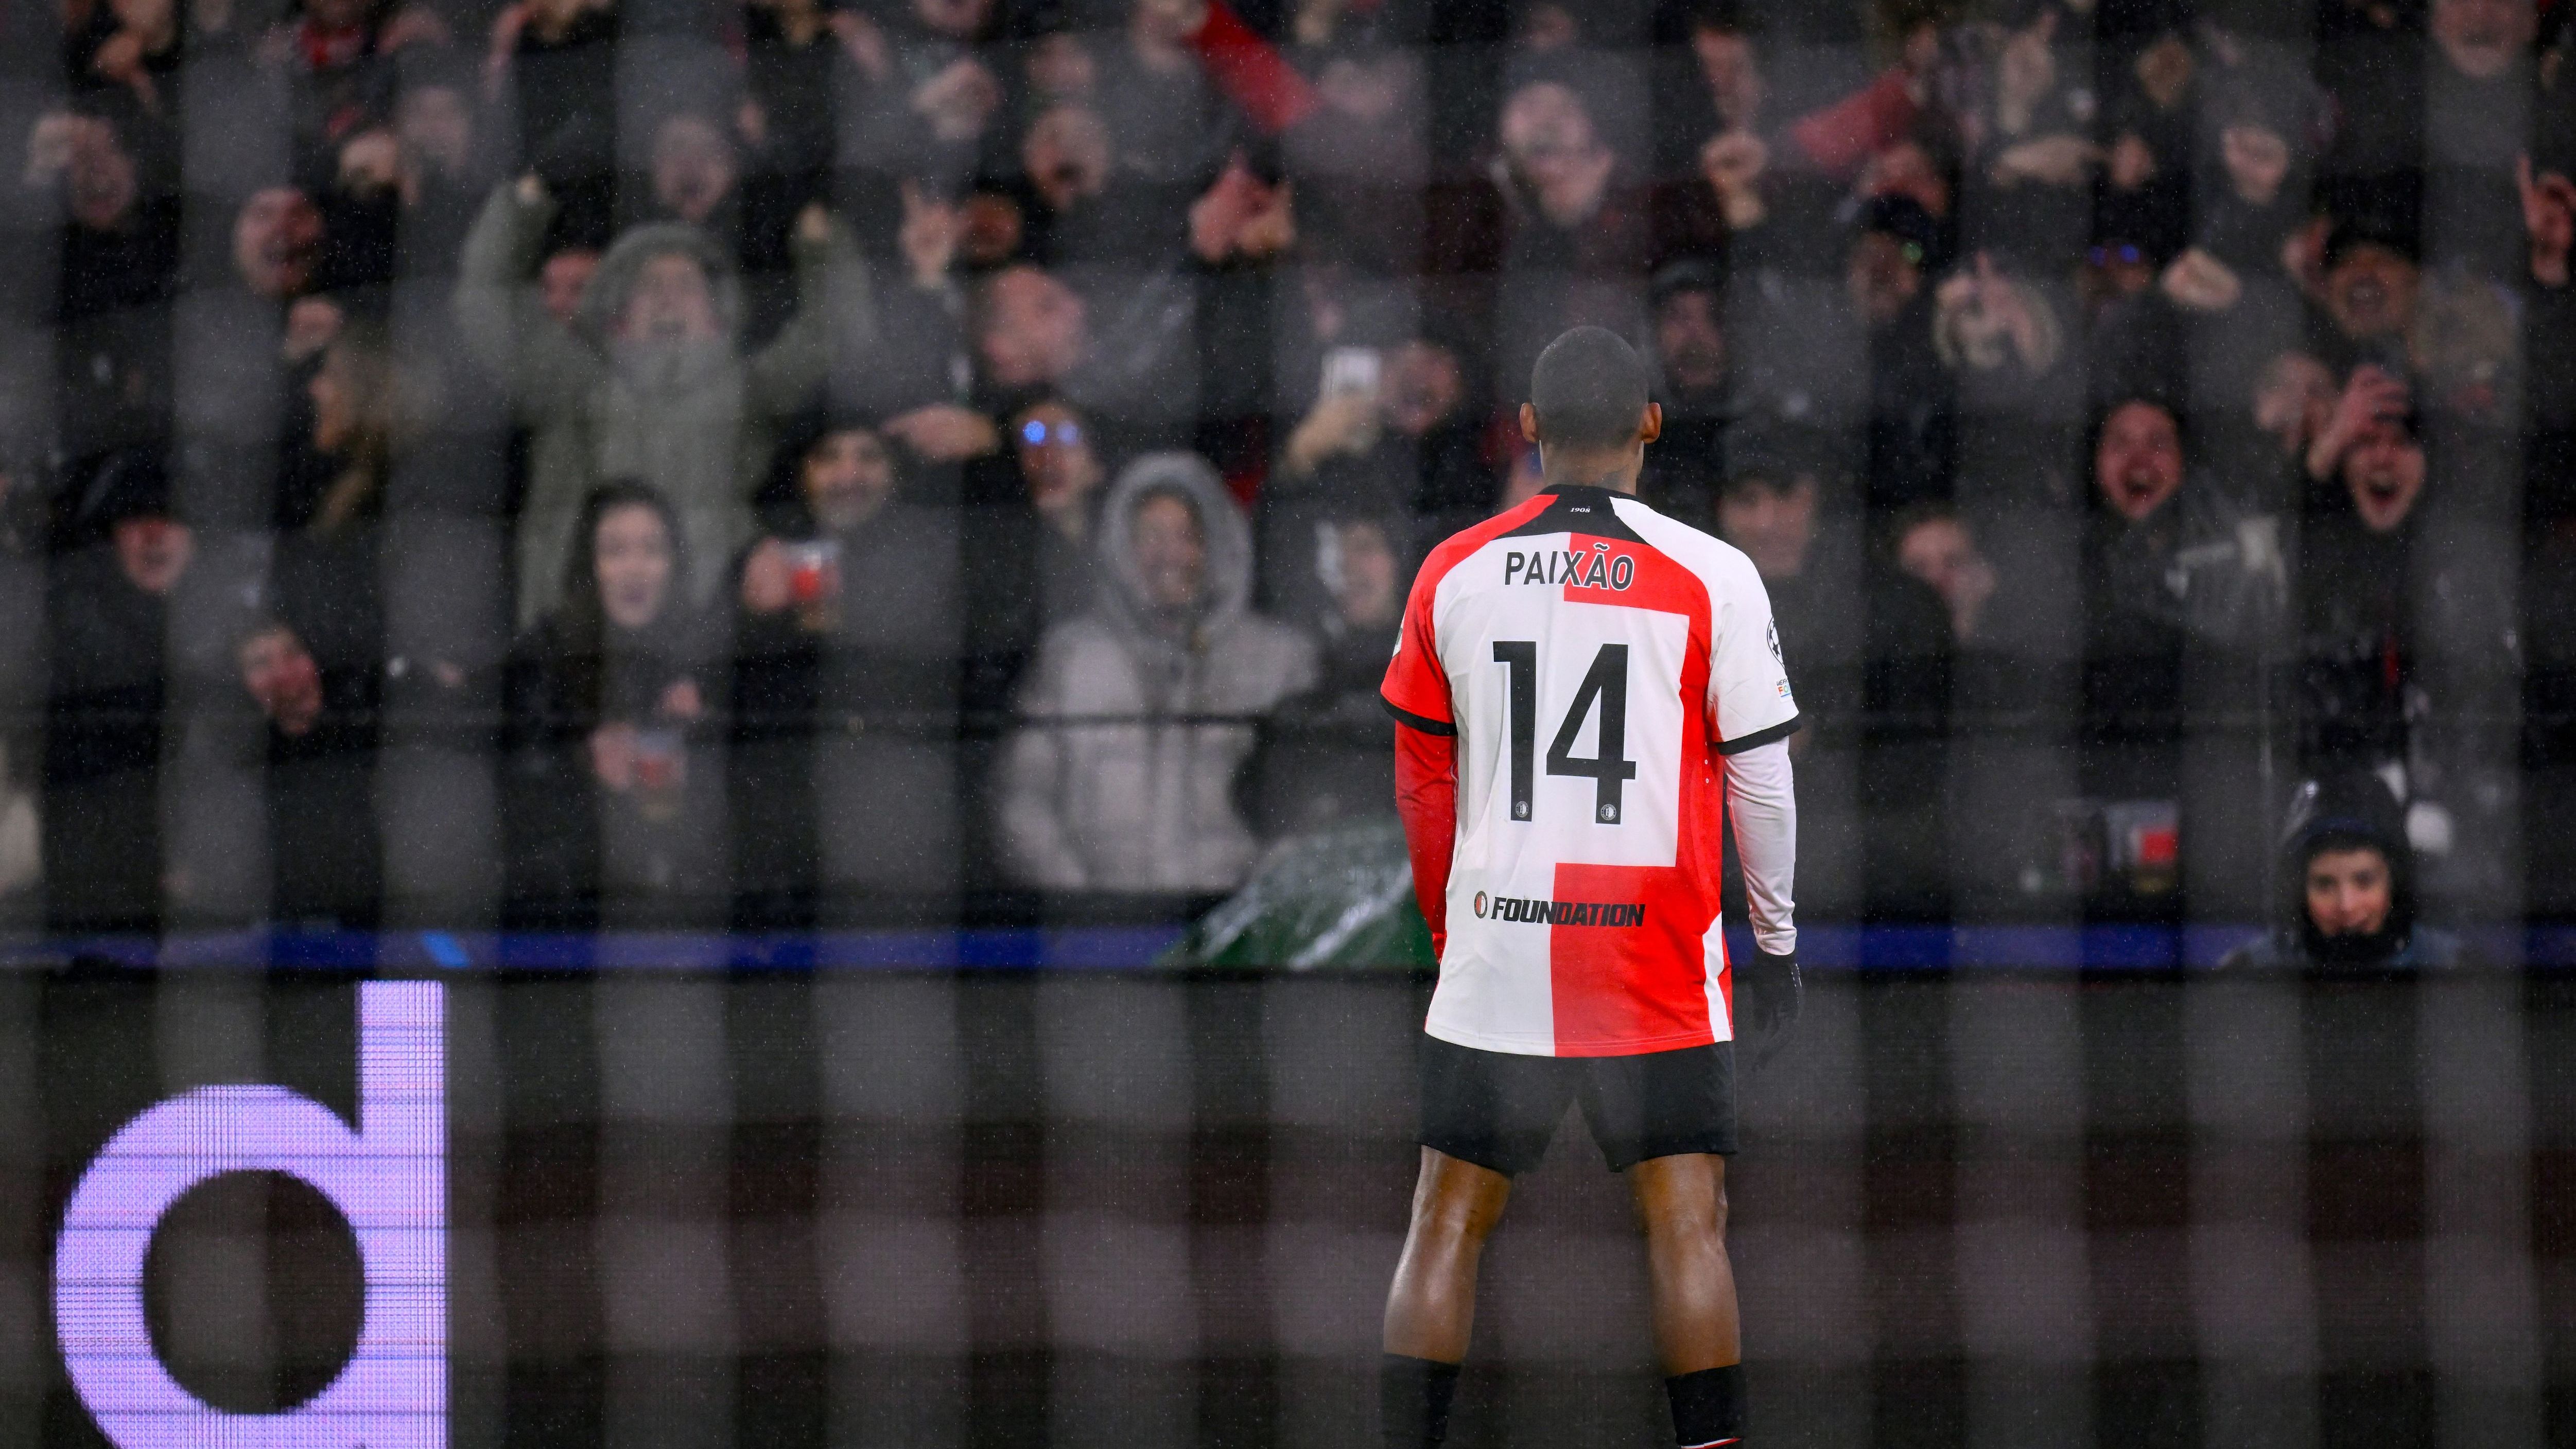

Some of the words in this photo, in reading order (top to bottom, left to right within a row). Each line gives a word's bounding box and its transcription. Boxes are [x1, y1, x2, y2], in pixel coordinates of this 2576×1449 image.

[1505, 542, 1634, 591] PAIXÃO
[1493, 641, 1637, 825] 14
[1491, 897, 1645, 927] FOUNDATION
[51, 980, 447, 1449] d
